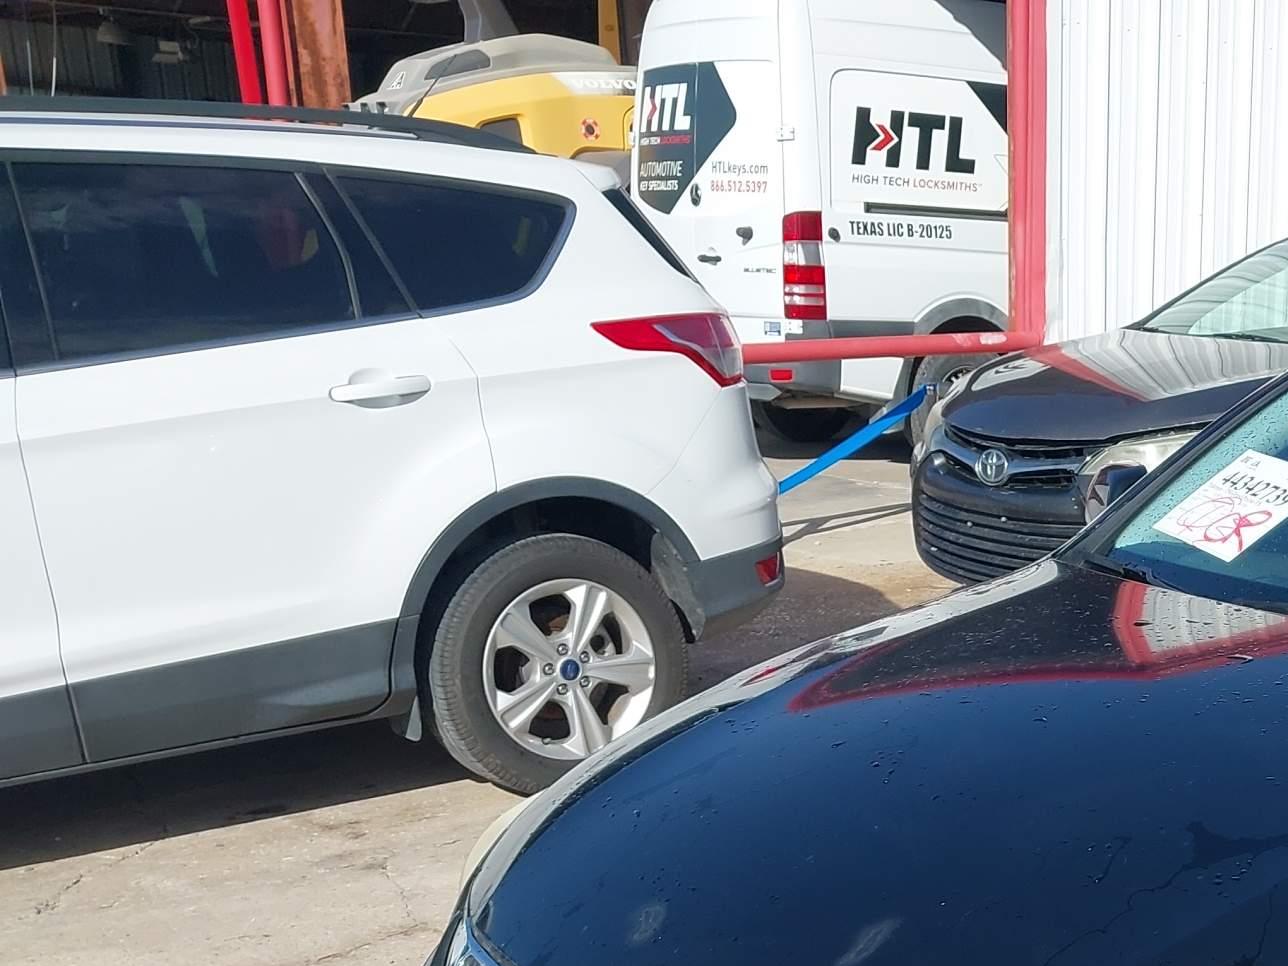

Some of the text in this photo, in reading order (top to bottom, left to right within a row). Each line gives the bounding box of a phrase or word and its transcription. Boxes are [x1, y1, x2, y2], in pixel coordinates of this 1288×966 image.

[570, 79, 637, 91] VOLVO
[640, 83, 691, 133] HTL
[851, 106, 976, 174] HTL
[640, 160, 684, 177] AUTOMOTIVE
[711, 160, 769, 178] HTLkeys.com
[648, 180, 679, 191] SPECIALISTS
[710, 180, 768, 193] 866.512.5397
[852, 173, 978, 193] HIGH TECH LOCKSMITHS
[849, 220, 953, 240] TEXAS LIC B-20125
